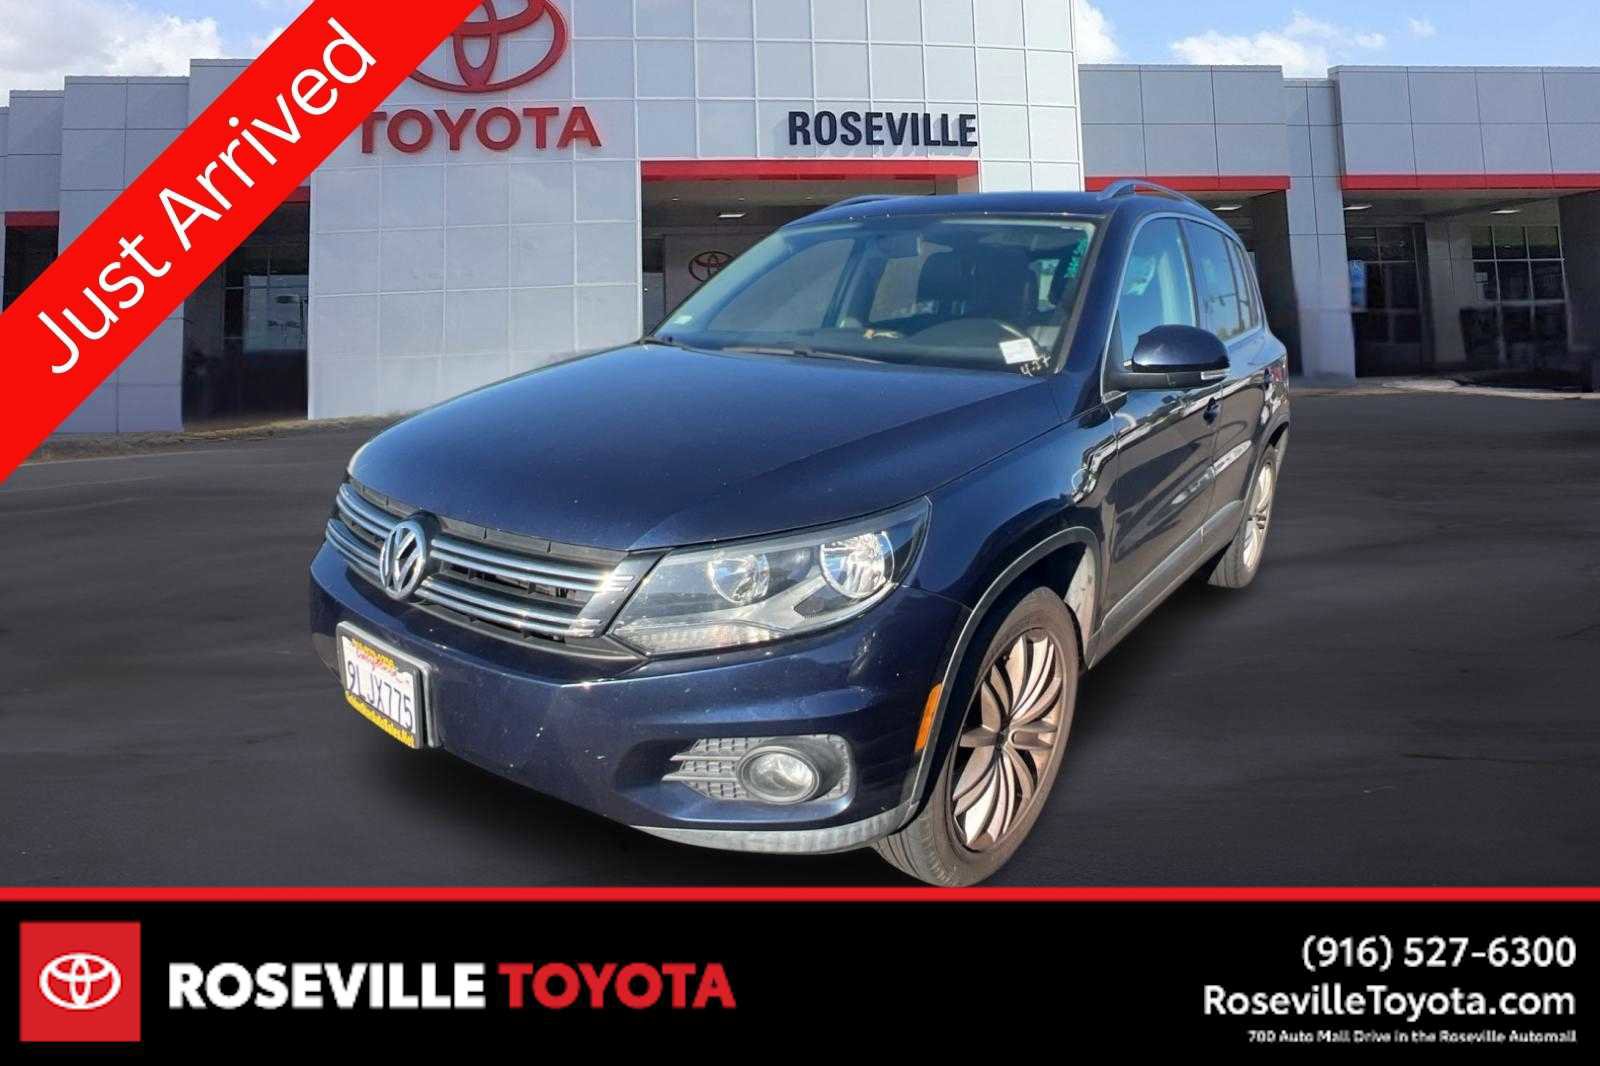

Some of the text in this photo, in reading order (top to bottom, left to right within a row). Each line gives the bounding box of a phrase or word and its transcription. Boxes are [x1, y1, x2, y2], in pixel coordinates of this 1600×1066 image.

[361, 106, 602, 153] TOYOTA
[788, 110, 978, 147] ROSEVILLE
[347, 660, 413, 731] 9LJX775
